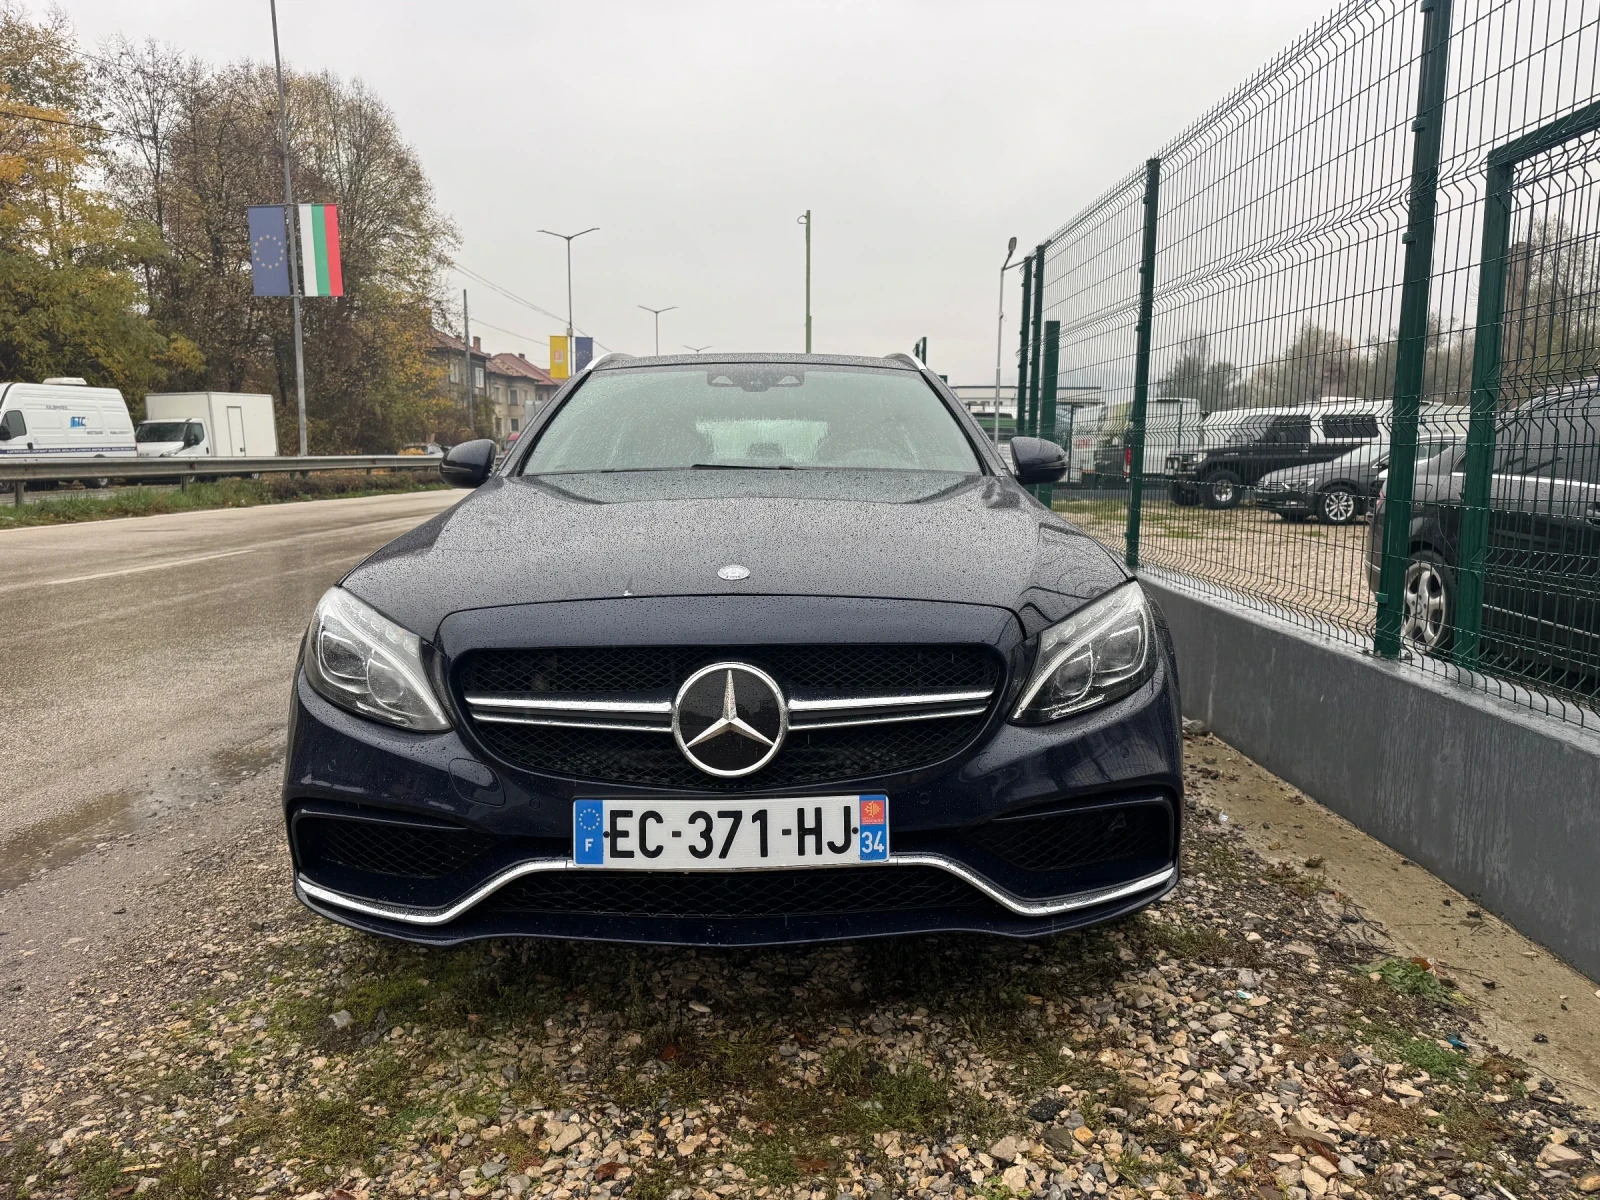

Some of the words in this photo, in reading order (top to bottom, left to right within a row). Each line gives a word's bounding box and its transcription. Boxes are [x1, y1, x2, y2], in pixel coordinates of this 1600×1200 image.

[610, 806, 851, 859] EC-371-HJ
[862, 831, 885, 854] 34
[585, 838, 594, 852] F
